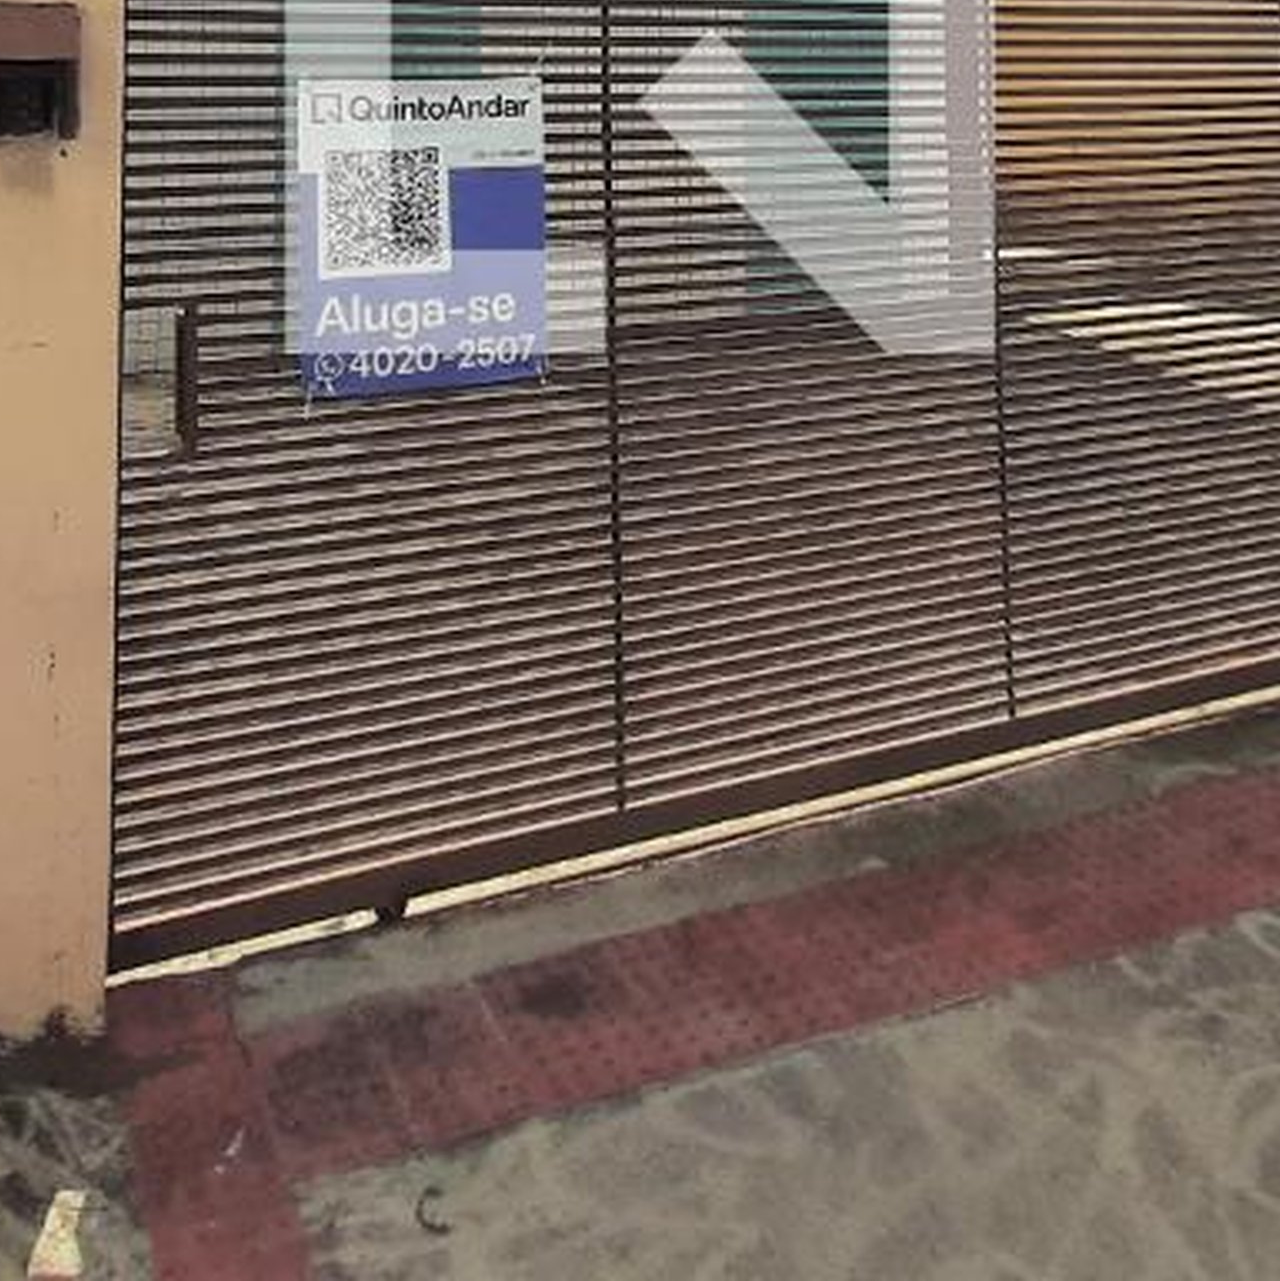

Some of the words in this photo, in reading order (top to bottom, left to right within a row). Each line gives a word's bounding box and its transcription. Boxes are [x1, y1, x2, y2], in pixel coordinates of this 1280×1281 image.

[349, 94, 530, 120] QuintoAndar
[316, 291, 516, 340] Aluga-se
[350, 333, 536, 379] 4020-2507
